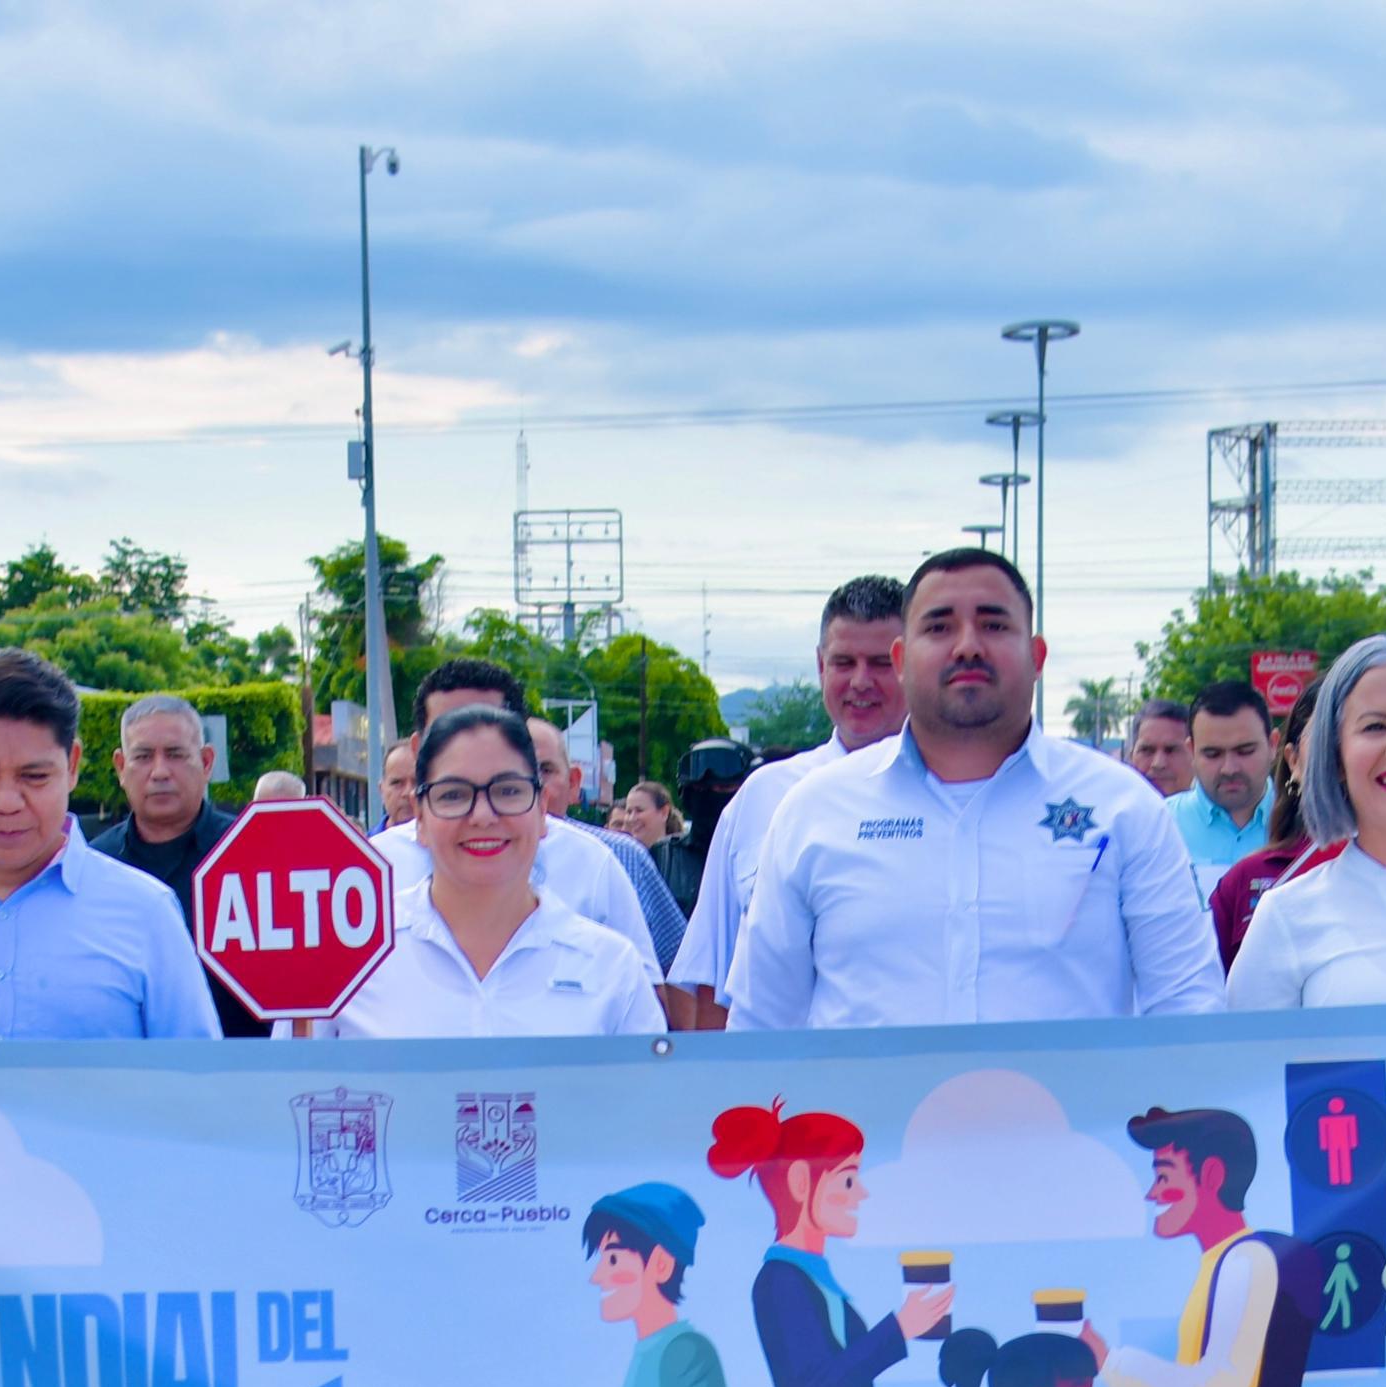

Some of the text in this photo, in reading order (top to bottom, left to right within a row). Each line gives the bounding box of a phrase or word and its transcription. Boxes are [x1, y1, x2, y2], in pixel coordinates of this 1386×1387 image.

[856, 829, 923, 840] PREVENTIVOS
[859, 817, 924, 829] PROGRAMAS
[210, 865, 378, 952] ALTO
[256, 1289, 350, 1363] DEL
